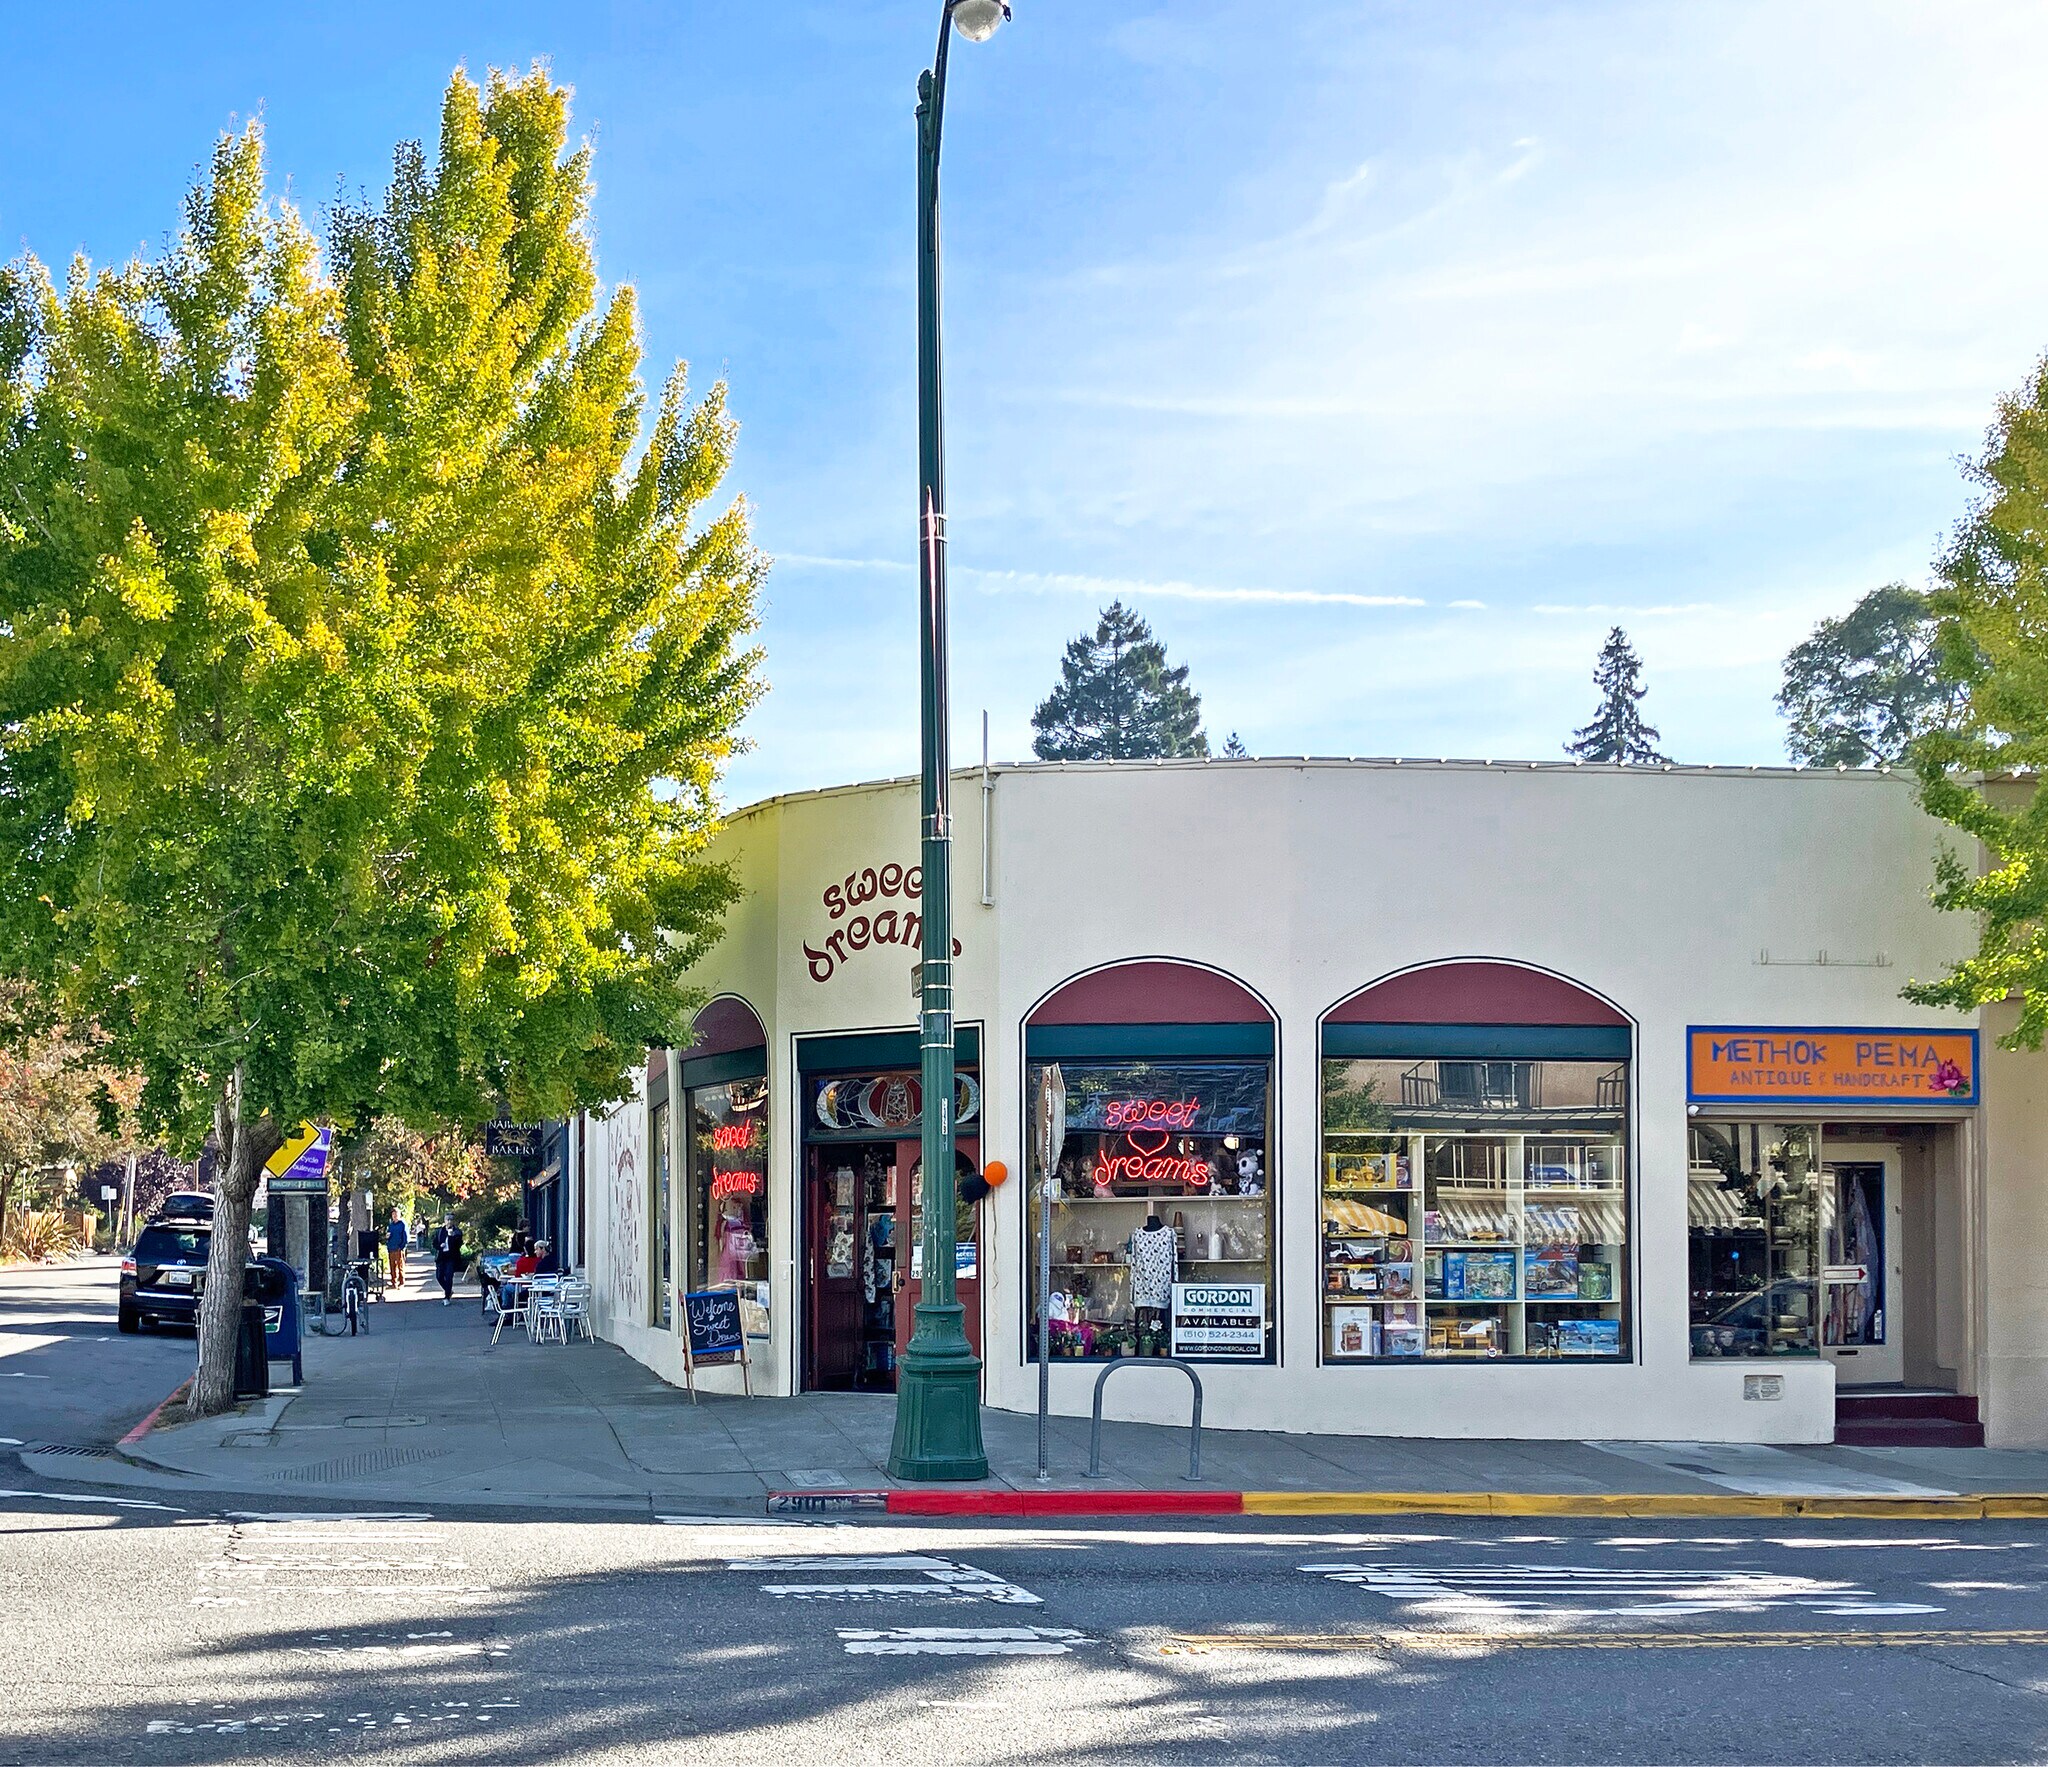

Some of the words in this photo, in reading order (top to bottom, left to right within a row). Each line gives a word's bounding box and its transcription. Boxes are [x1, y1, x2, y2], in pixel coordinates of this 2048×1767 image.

[823, 863, 922, 920] swee
[1855, 1042, 1941, 1068] PEMA
[1730, 1070, 1813, 1086] ANTIQUE
[1106, 1096, 1201, 1129] sweet
[713, 1119, 751, 1151] sweet
[301, 1155, 319, 1164] cycle
[492, 1145, 537, 1155] BAKERY
[293, 1164, 322, 1174] oulevard
[1095, 1149, 1209, 1186] dreams
[712, 1163, 757, 1200] dreams
[1186, 1289, 1251, 1304] GORDON
[693, 1314, 730, 1336] Sweet
[1183, 1318, 1252, 1327] AVAILABLE
[1184, 1330, 1206, 1339] (510)
[1209, 1330, 1254, 1339] 524-2344
